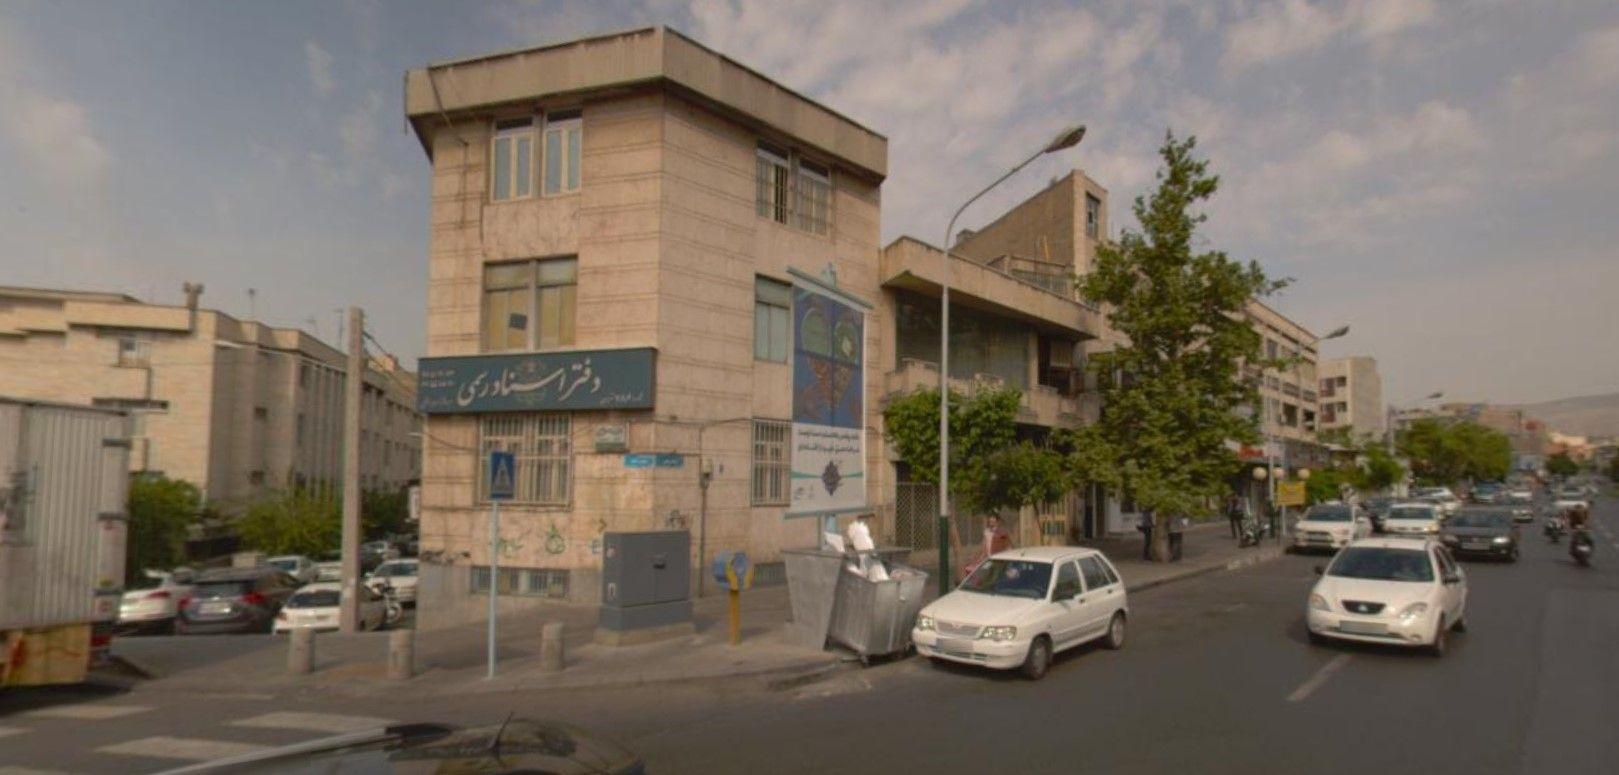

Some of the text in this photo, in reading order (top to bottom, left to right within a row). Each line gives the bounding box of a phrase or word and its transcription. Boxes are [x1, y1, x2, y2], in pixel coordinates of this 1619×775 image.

[457, 370, 488, 406] رسمی
[491, 367, 566, 396] اسناد
[558, 357, 600, 401] دفتر
